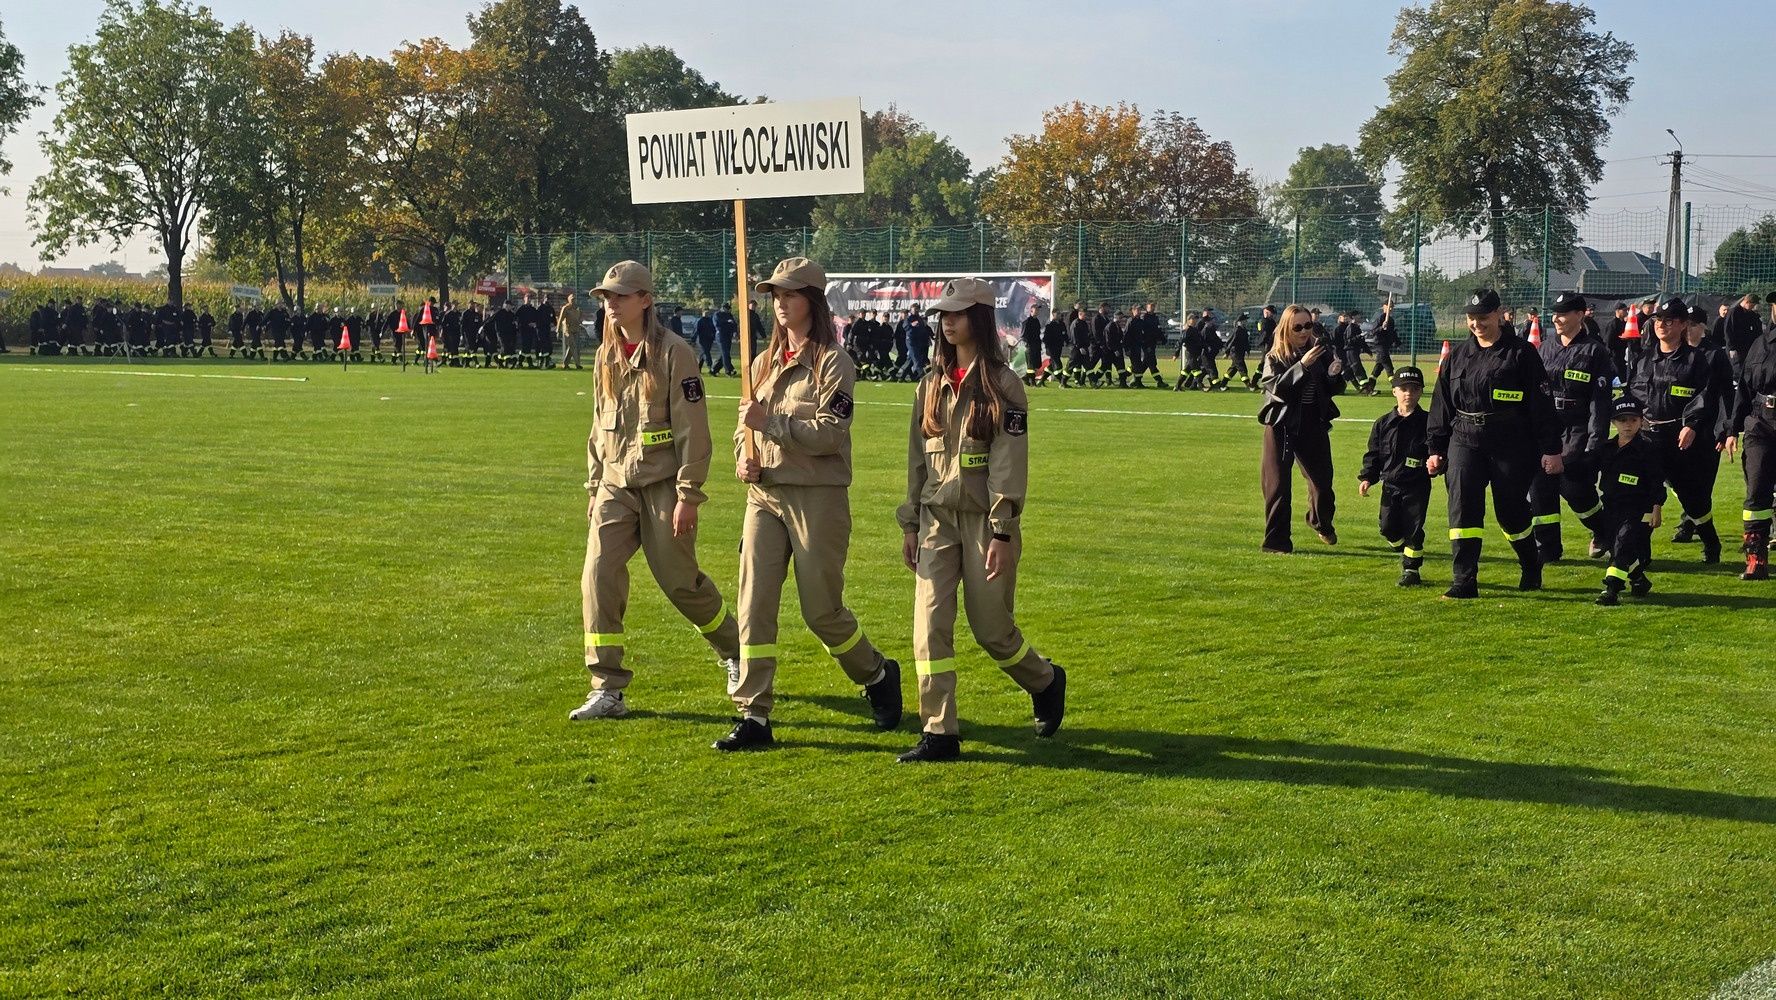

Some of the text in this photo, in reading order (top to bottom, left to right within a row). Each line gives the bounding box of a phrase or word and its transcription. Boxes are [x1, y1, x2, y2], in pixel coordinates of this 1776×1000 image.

[638, 121, 850, 180] POWIAT WŁOCŁAWSKI
[651, 431, 673, 442] STRA
[968, 456, 989, 465] STRA
